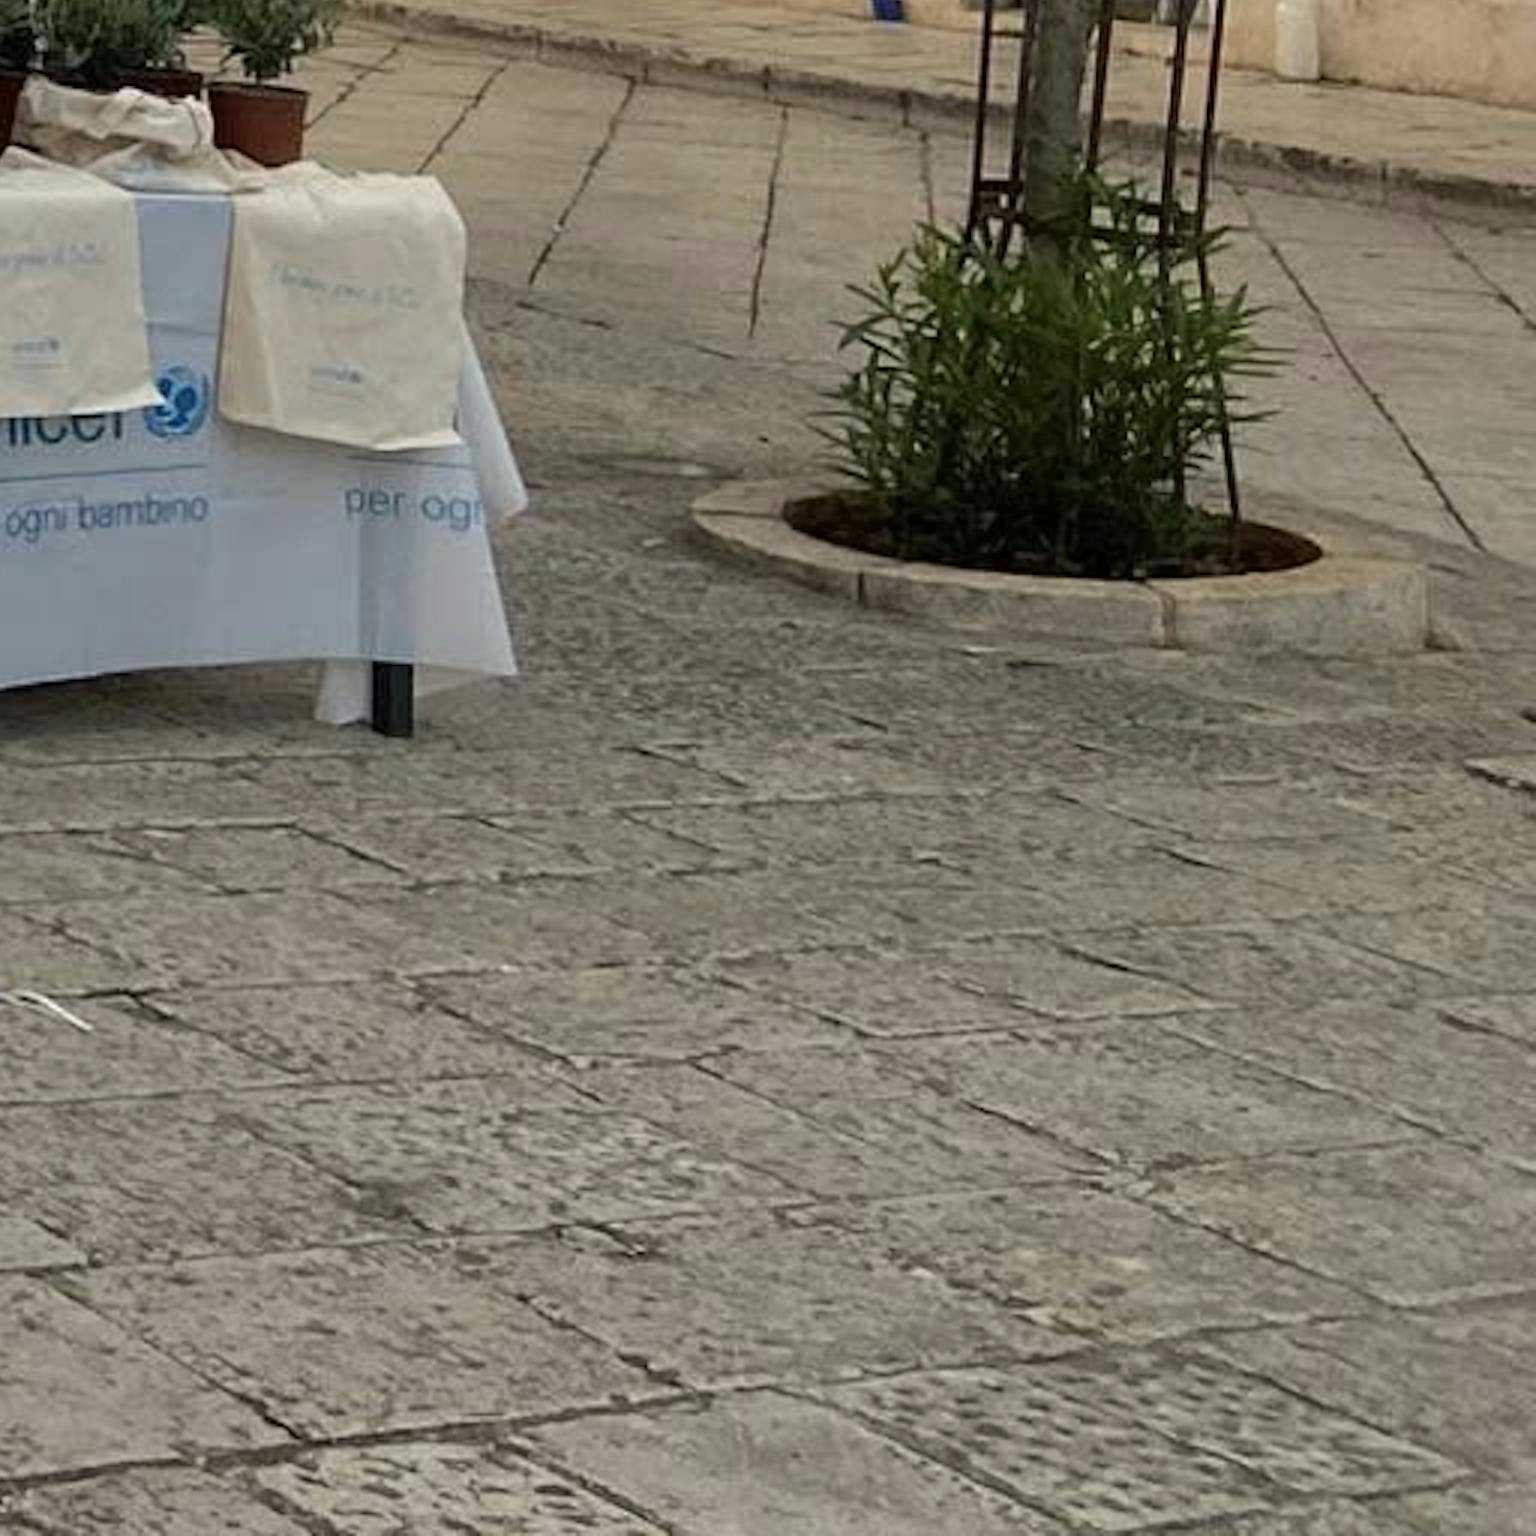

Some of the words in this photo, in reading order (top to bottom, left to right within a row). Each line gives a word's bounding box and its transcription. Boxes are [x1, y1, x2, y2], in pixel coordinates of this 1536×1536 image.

[5, 506, 68, 543] ogni
[78, 494, 210, 530] bambino
[345, 488, 407, 522] per
